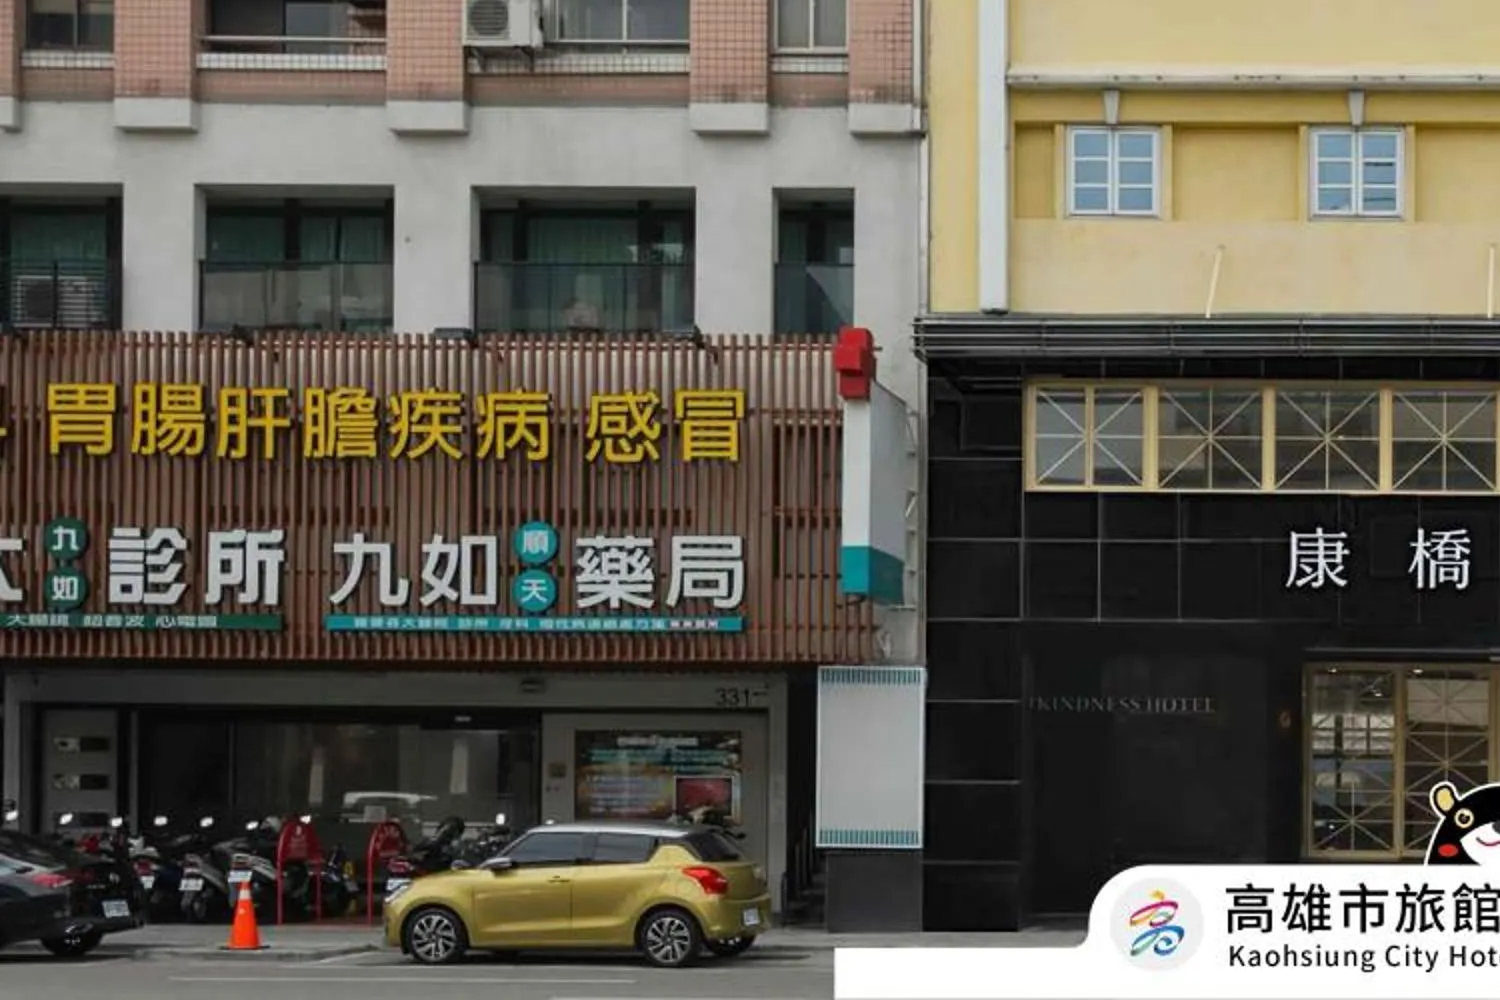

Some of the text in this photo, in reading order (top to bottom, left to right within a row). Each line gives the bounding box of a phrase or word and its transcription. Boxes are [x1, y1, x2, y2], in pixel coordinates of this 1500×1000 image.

[47, 381, 550, 461] 胃腸肝膽疾病
[585, 389, 745, 463] 感冒
[52, 525, 79, 600] 九如
[108, 527, 285, 605] 診所
[329, 530, 745, 609] 九如 順天 藥局
